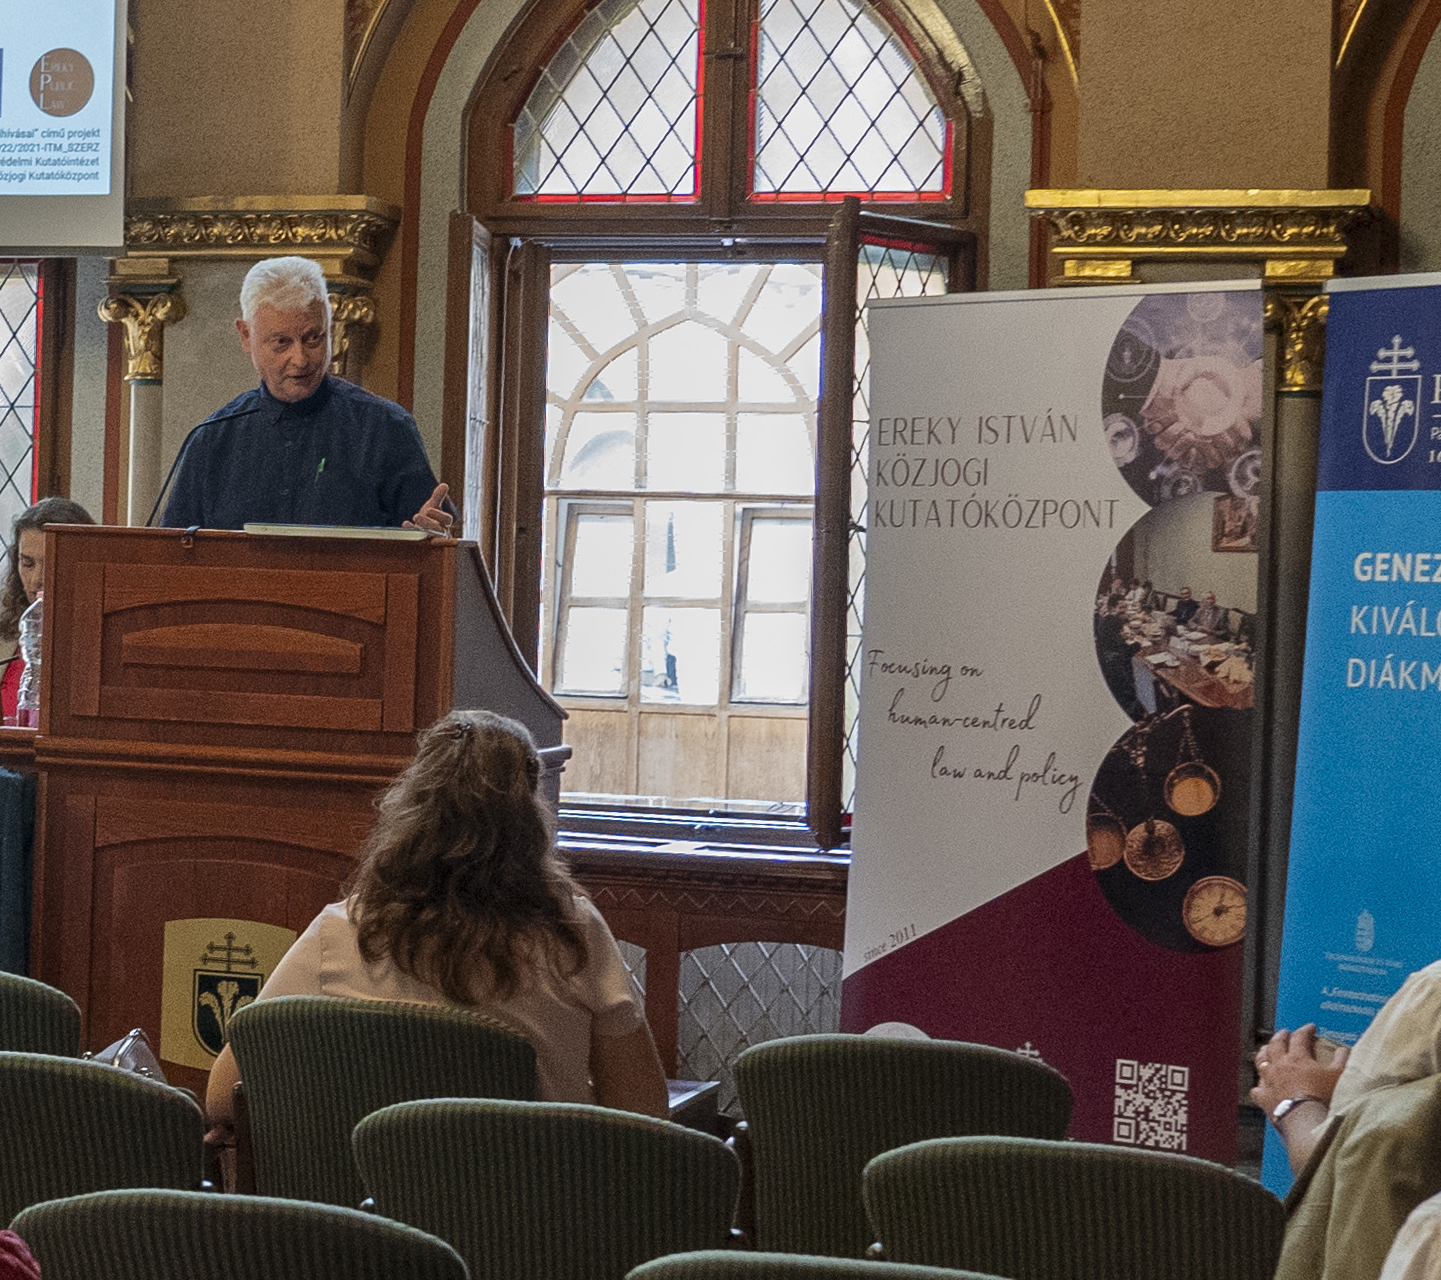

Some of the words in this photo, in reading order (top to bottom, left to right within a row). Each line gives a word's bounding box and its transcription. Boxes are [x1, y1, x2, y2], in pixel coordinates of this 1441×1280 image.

[41, 127, 65, 139] című
[67, 127, 100, 140] projekt
[28, 170, 99, 182] Kutatóközpont
[35, 157, 100, 167] Kutatóintézet
[878, 417, 962, 446] EREKY
[977, 408, 1078, 445] ISTVÁN
[876, 453, 989, 487] KÖZJOGI
[873, 493, 1120, 529] KUTATÓKÖZPONT
[868, 649, 953, 702] Focusing
[960, 665, 983, 677] on
[888, 687, 1042, 731] human-centred
[930, 745, 967, 779] law
[973, 744, 1020, 781] and
[1015, 752, 1085, 814] policy
[864, 942, 887, 962] since
[889, 923, 917, 948] 2011
